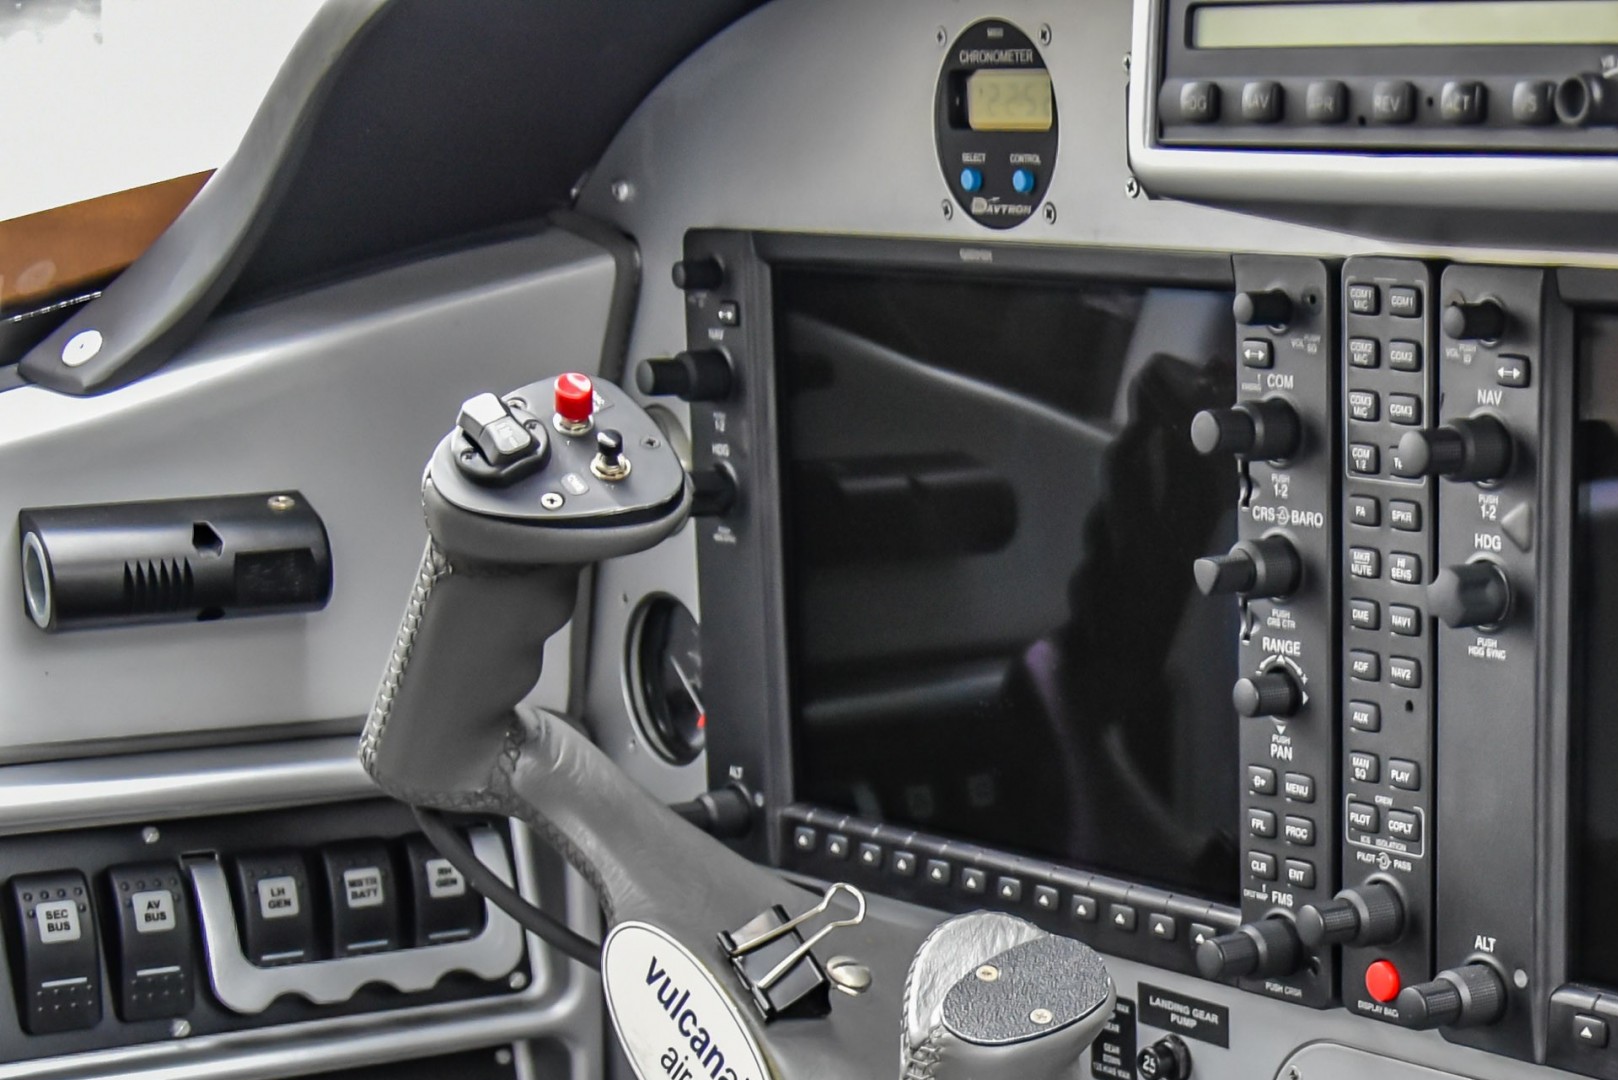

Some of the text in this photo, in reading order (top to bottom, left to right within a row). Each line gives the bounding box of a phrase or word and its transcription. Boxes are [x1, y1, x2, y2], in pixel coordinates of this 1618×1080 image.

[959, 49, 1033, 64] CHRONOMETER
[1267, 374, 1294, 389] COM
[1477, 389, 1502, 407] NAV
[1252, 505, 1324, 527] CRS BARO
[1475, 533, 1501, 549] HDG
[1262, 637, 1301, 656] RANGE
[1270, 744, 1293, 761] PAN
[1286, 781, 1309, 796] MENU
[1251, 817, 1266, 831] FPL
[1286, 824, 1309, 840] PROC
[1288, 868, 1304, 882] ENT
[271, 887, 285, 897] LH
[1271, 891, 1294, 907] FMS
[147, 900, 161, 910] AV
[268, 898, 291, 910] GEN
[45, 909, 69, 920] SEC
[144, 912, 167, 923] BUS
[47, 921, 71, 932] BUS
[1475, 935, 1496, 952] ALT
[1149, 996, 1190, 1015] LANDING
[1192, 1008, 1219, 1025] GEAR
[1170, 1014, 1197, 1029] PUMP
[1143, 1055, 1156, 1074] 25
